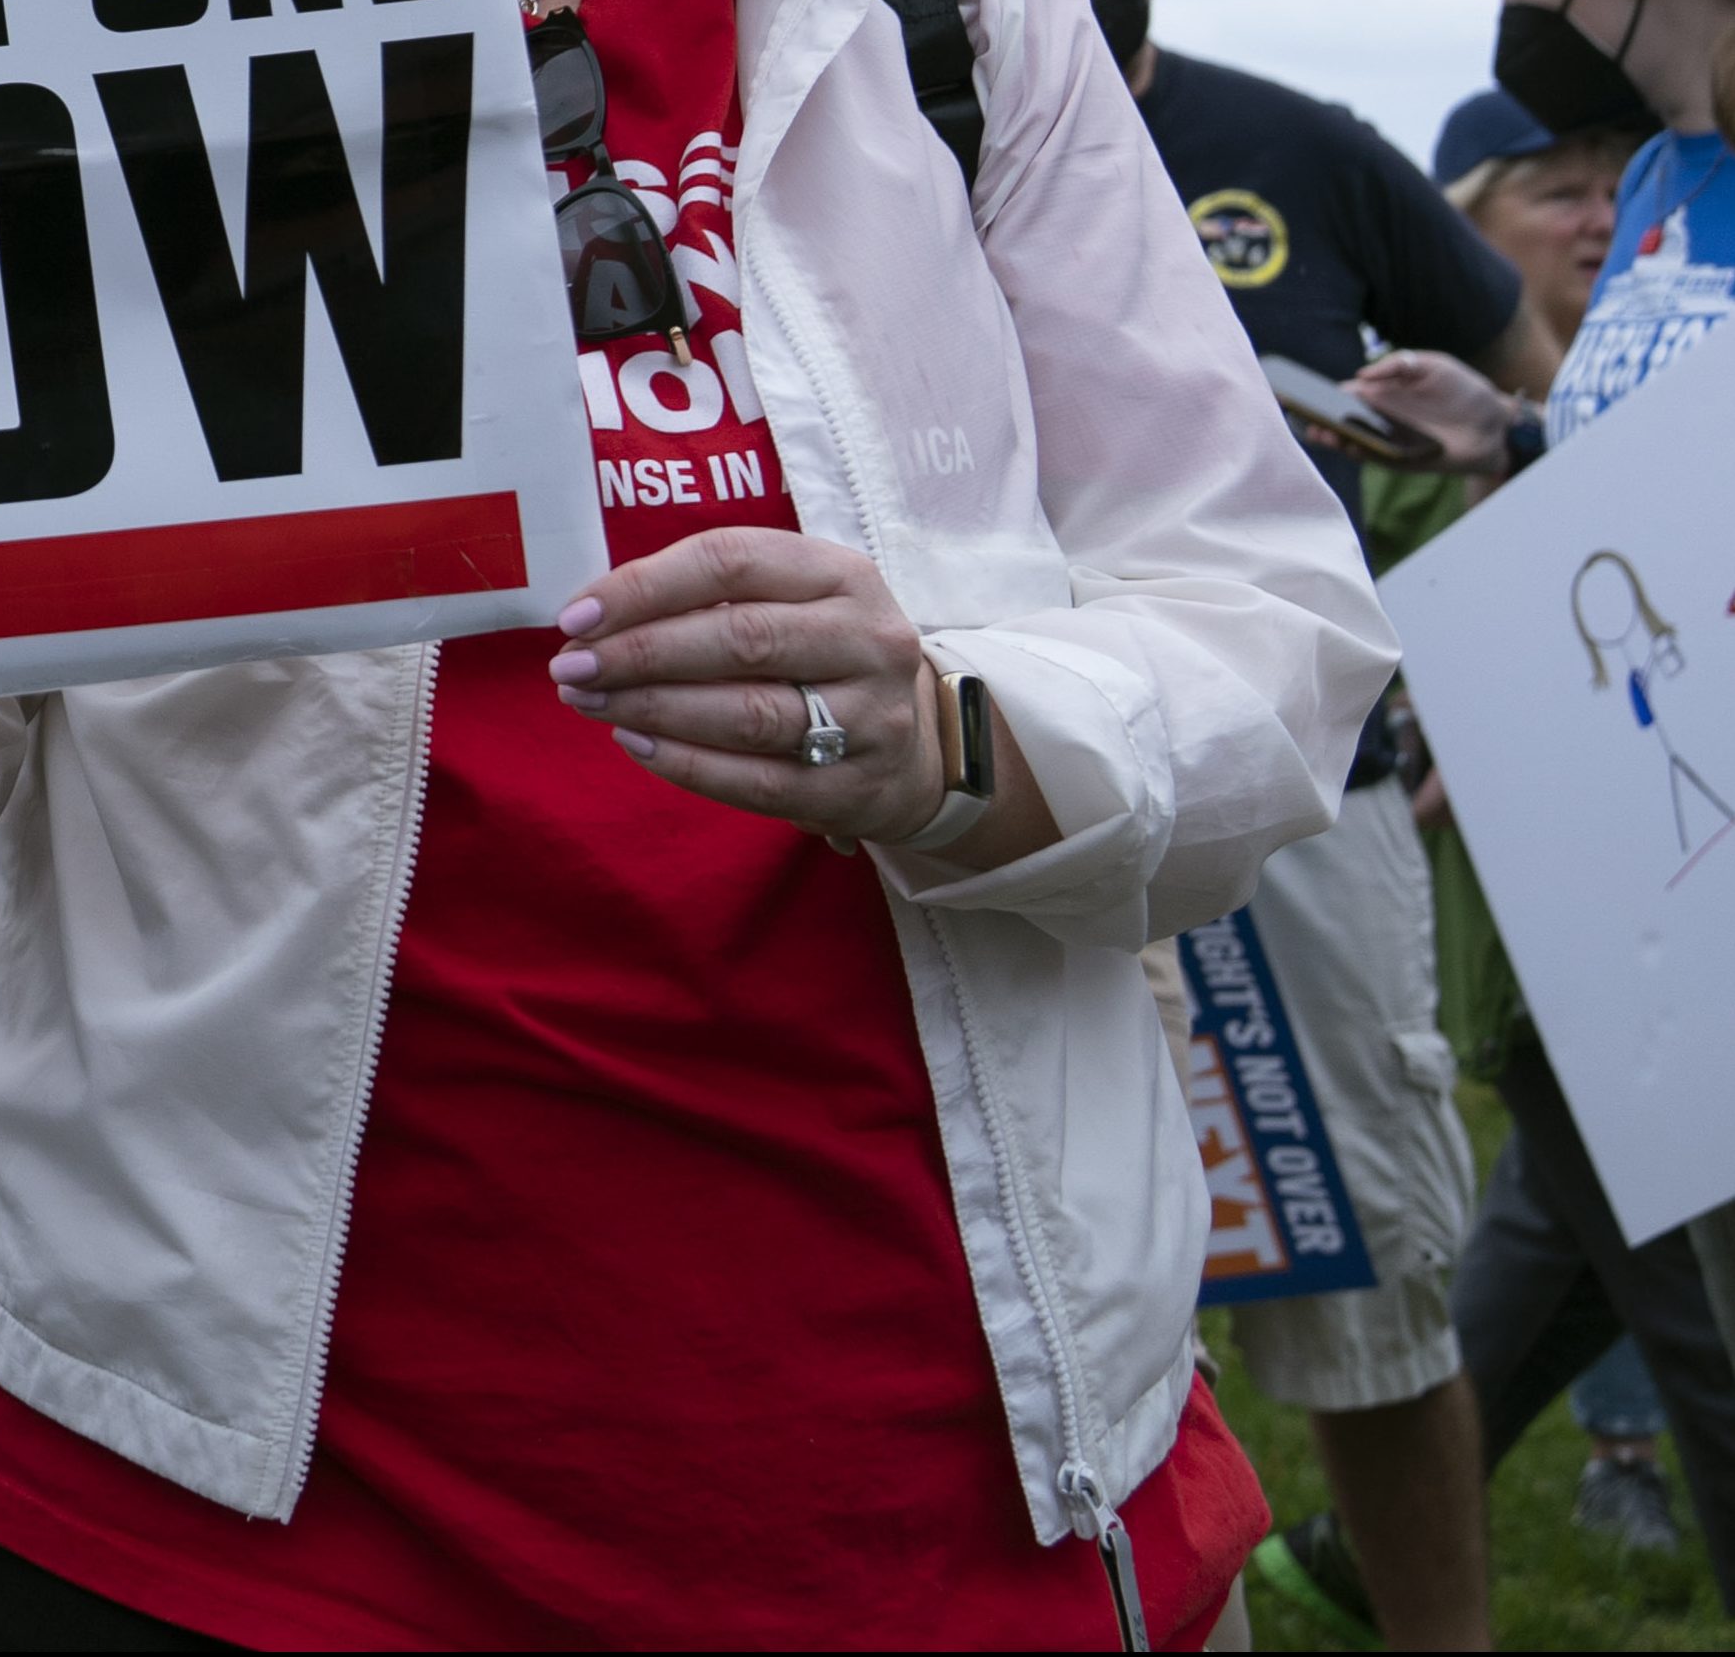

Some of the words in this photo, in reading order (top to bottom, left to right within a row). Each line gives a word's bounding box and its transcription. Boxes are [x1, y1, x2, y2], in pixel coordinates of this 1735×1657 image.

[599, 458, 701, 508] NSE
[707, 449, 765, 502] IN
[1189, 916, 1276, 1050] IGHT'S
[1234, 1053, 1309, 1140] NOT
[1265, 1143, 1344, 1256] OVER
